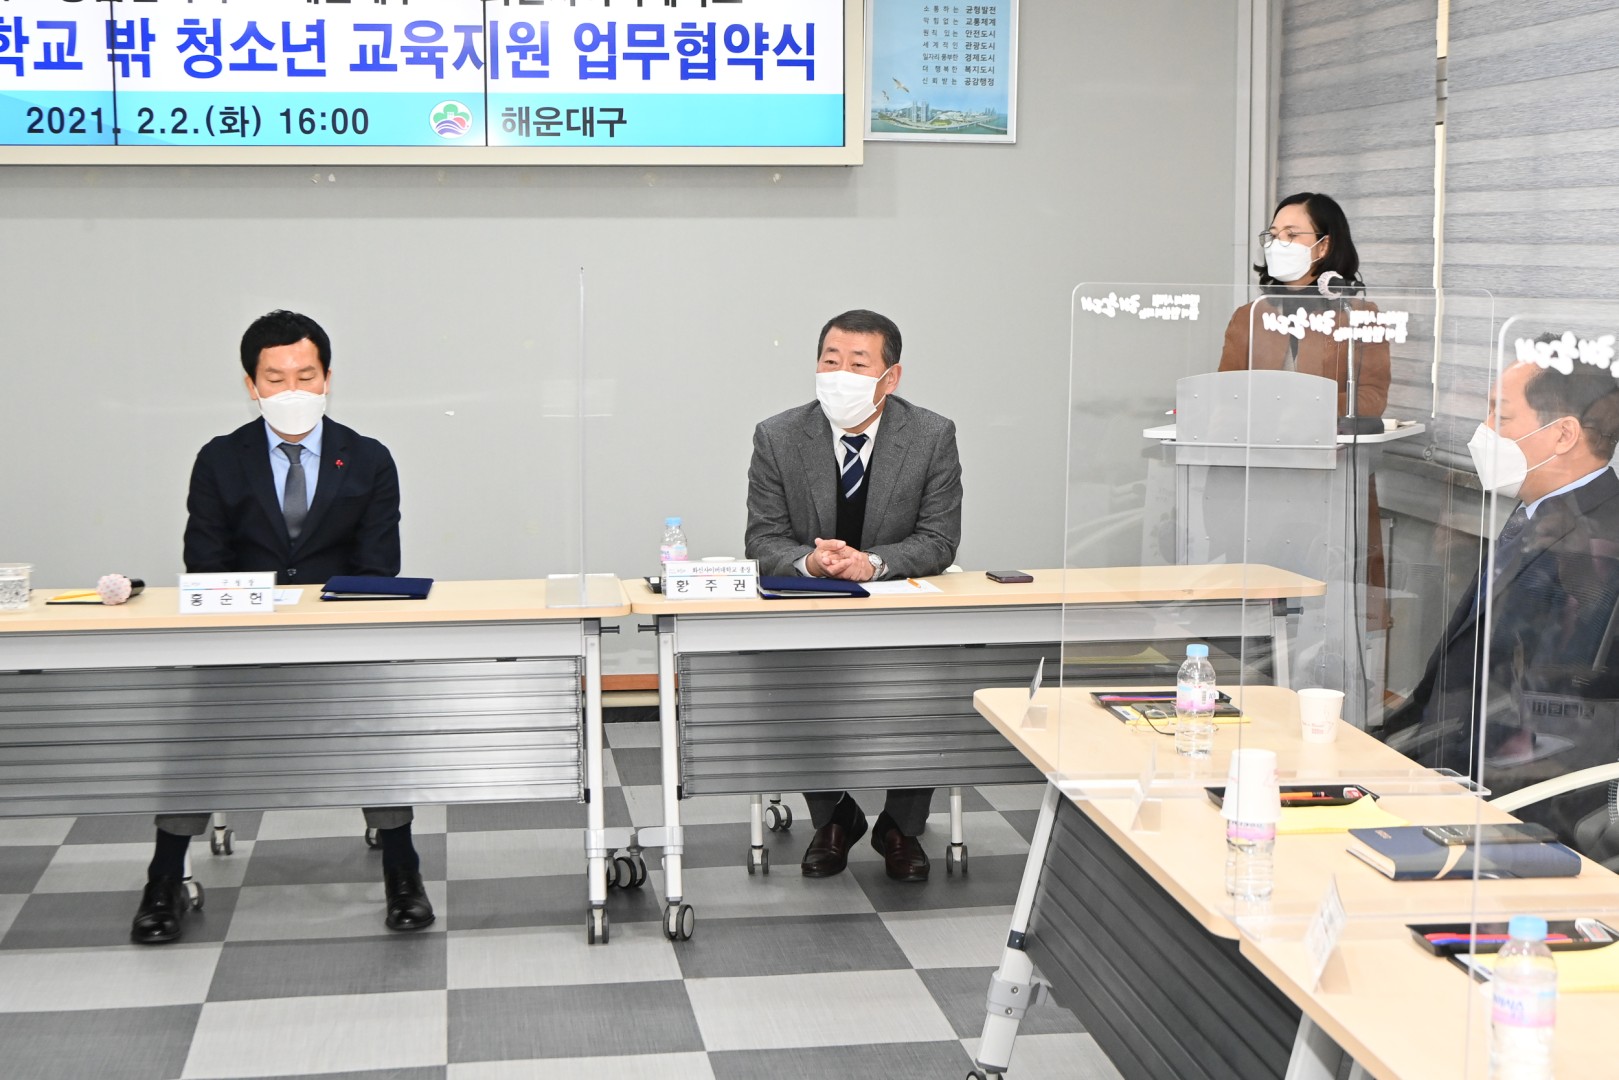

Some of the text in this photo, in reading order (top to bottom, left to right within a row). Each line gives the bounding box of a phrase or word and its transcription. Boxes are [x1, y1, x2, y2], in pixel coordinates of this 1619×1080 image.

[966, 6, 996, 14] 균형발전
[966, 18, 996, 26] 교통체계
[966, 30, 995, 38] 안전도시
[106, 18, 156, 78] 밖
[177, 18, 327, 79] 청소년
[350, 20, 550, 80] 교육지원
[574, 22, 815, 81] 업무협약식
[964, 78, 994, 86] 공감행정
[27, 105, 370, 138] 2021. 2.2.(화) 16:00
[501, 106, 628, 138] 해운대구
